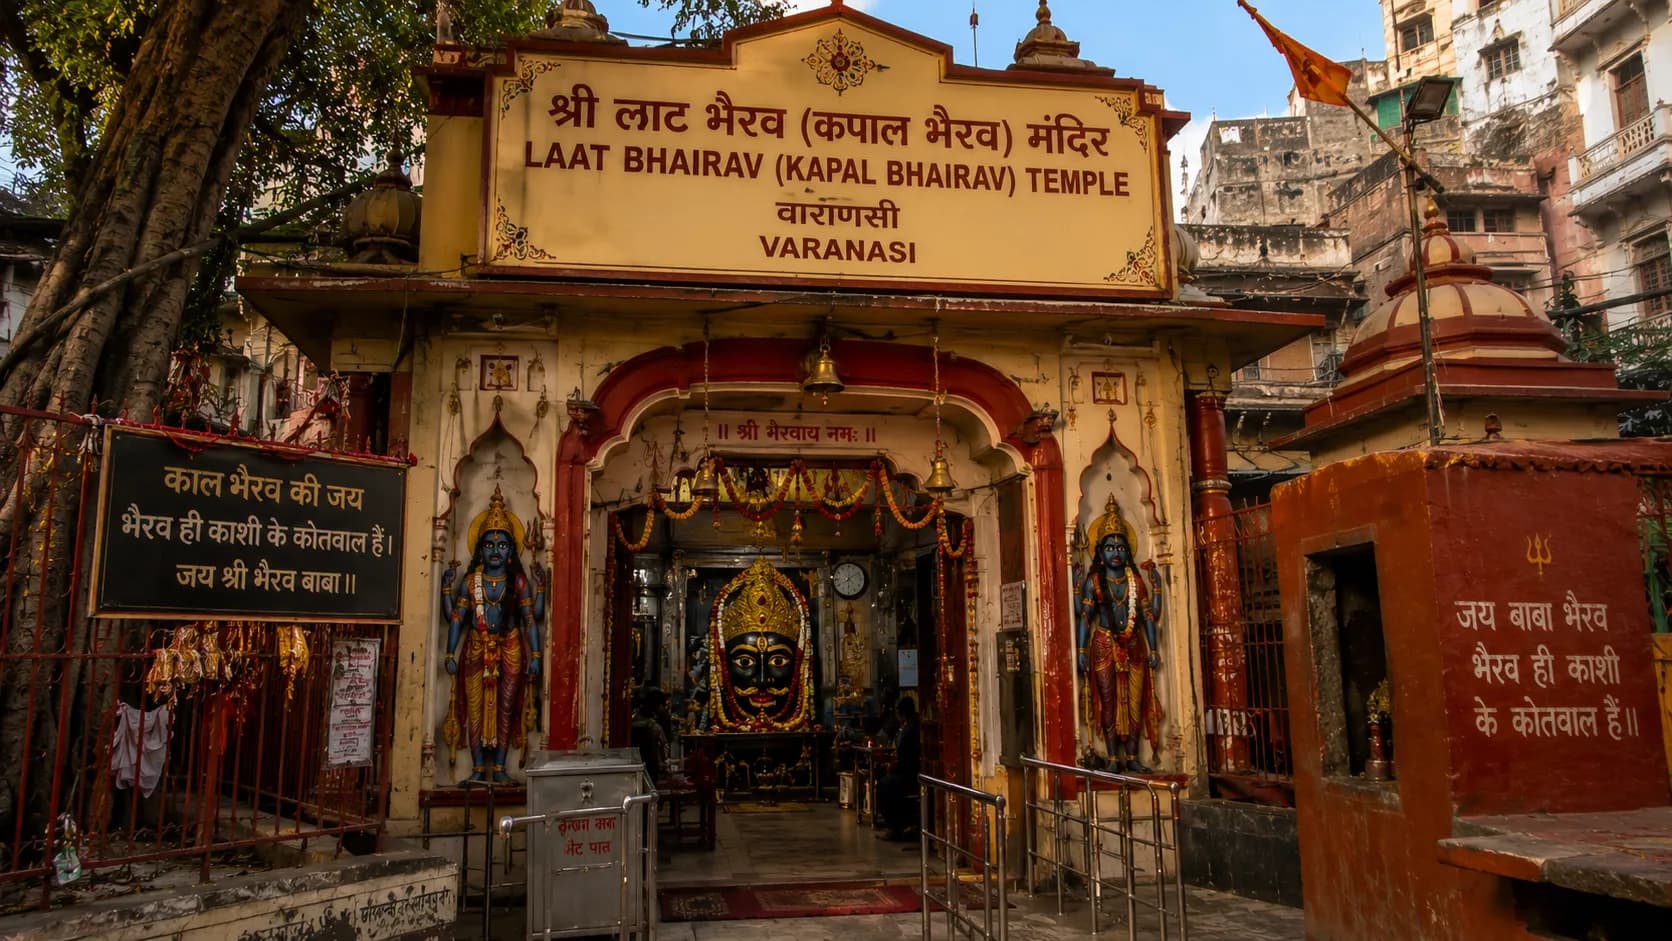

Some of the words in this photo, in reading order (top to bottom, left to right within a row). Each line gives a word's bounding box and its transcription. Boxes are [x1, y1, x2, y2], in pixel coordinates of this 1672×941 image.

[548, 83, 599, 128] श्री
[614, 99, 690, 132] लाट
[706, 91, 787, 138] भैरव
[801, 107, 911, 147] (कपाल
[925, 105, 1012, 157] भैरव)
[1026, 113, 1110, 156] मंदिर
[525, 141, 610, 171] LAAT
[624, 146, 763, 178] BHAIRAV
[776, 153, 876, 187] (KAPAL
[887, 160, 1015, 197] BHAIRAV)
[1025, 168, 1130, 196] TEMPLE
[775, 199, 900, 228] वाराणसी
[759, 236, 916, 263] VARANASI
[737, 419, 760, 440] श्री
[766, 419, 820, 441] भैरवाय
[826, 426, 858, 442] नमः
[164, 466, 224, 497] काल
[229, 464, 283, 503] भैरव
[290, 473, 321, 507] की
[327, 484, 364, 511] जय
[122, 503, 173, 540] भैरव
[179, 510, 204, 545] ही
[208, 515, 262, 546] काशी
[267, 517, 287, 547] के
[293, 520, 368, 553] कोतवाल
[176, 564, 216, 589] जय
[222, 559, 248, 590] श्री
[254, 559, 297, 592] भैरव
[1454, 601, 1496, 631] जय
[1508, 602, 1553, 631] बाबा
[1563, 590, 1608, 632] भैरव
[1472, 641, 1519, 684] भैरव
[1531, 644, 1554, 688] ही
[1566, 645, 1620, 684] काशी
[1474, 696, 1497, 737] के
[1510, 696, 1598, 737] कोतवाल
